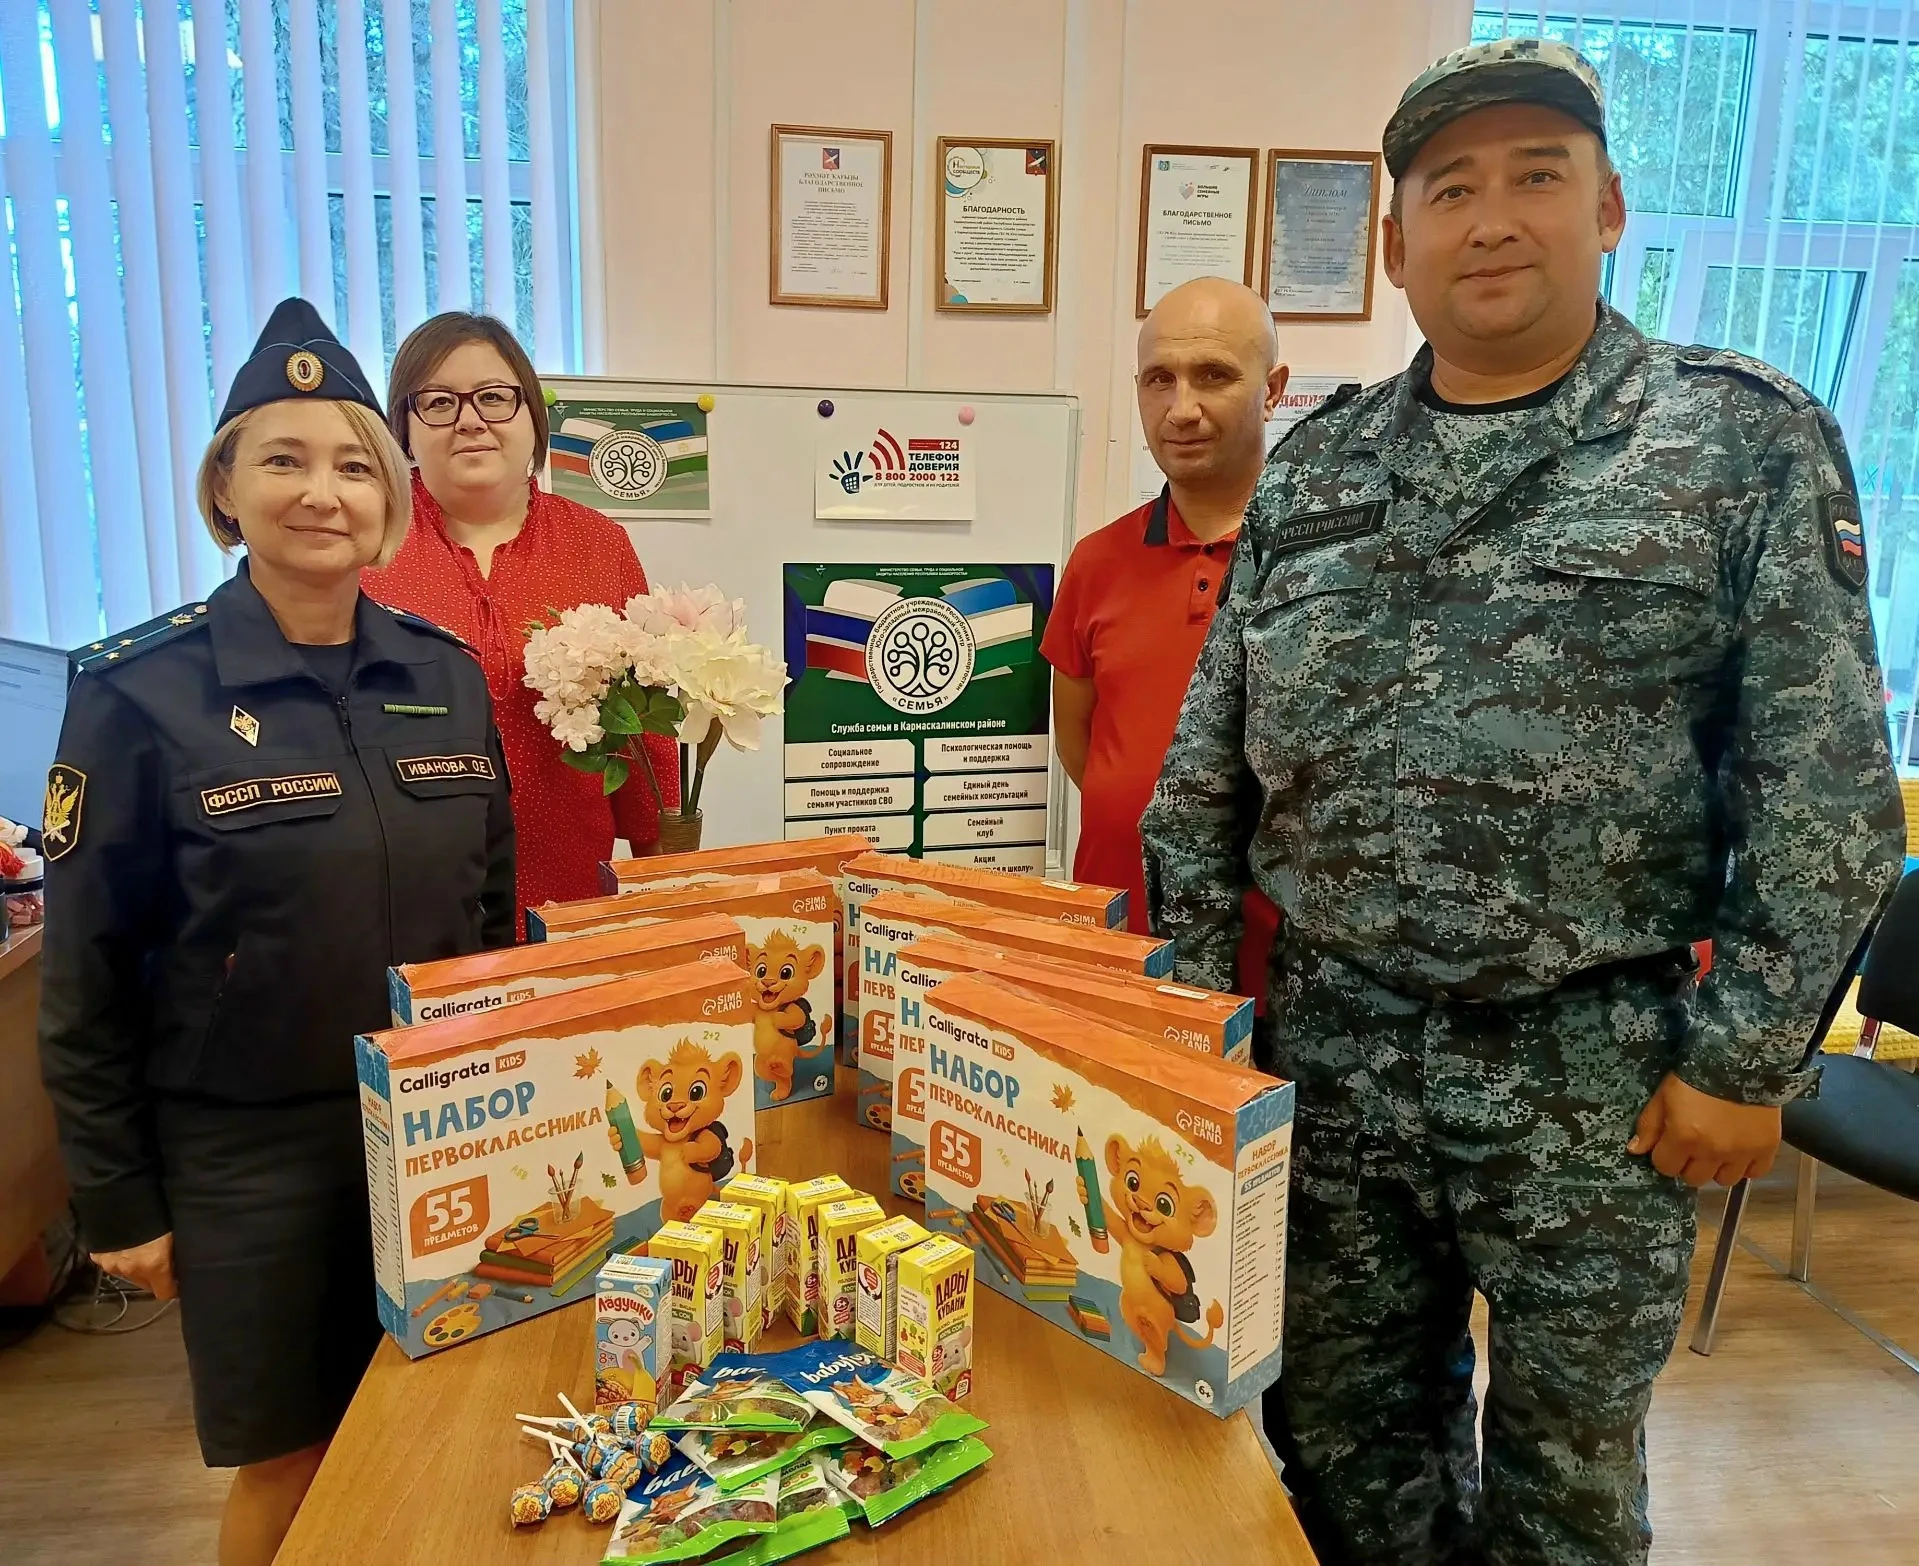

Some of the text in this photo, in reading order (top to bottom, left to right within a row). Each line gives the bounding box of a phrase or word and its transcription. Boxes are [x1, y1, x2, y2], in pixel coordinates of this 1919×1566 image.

[963, 205, 1026, 214] БЛАГОДАРНОСТЬ
[1163, 210, 1233, 219] БЛАГОДАРСТВЕННОЕ
[939, 441, 958, 450] 124
[908, 453, 959, 461] ТЕЛЕФОН
[908, 463, 959, 472] ДОВЕРИЯ
[875, 473, 959, 482] 8 800 2000 122
[892, 696, 949, 711] «СЕМЬЯ»
[831, 719, 1006, 735] Служба семьи в Кармаскалинском районе
[828, 748, 873, 758] Социальное
[941, 742, 1032, 753] Психологическая помощь
[821, 759, 880, 770] сопровождение
[969, 754, 1010, 764] поддержка
[407, 760, 468, 775] ИВАНОВА
[810, 788, 840, 797] Помощь
[847, 786, 890, 796] поддержка
[963, 780, 1009, 791] Единый день
[208, 777, 337, 808] ФССП РОССИИ
[943, 790, 1028, 802] семейных консультаций
[806, 796, 893, 809] семьям участников СВО
[967, 816, 1004, 827] Семейный
[824, 824, 876, 836] Пункт проката
[976, 829, 994, 838] клуб
[973, 855, 996, 864] Акция
[1007, 865, 1034, 874] школу»
[848, 881, 879, 898] Callig
[805, 896, 826, 905] SIMA
[805, 903, 827, 913] LAND
[1073, 914, 1096, 925] SIMA
[792, 924, 808, 934] 2+2
[864, 921, 914, 942] Calligrat
[714, 945, 737, 957] SIMA
[717, 991, 742, 1001] SIMA
[717, 1000, 743, 1013] LAND
[703, 1030, 720, 1041] 2+2
[928, 1014, 988, 1050] Calligrata
[1181, 1029, 1210, 1044] SIMA
[399, 1061, 491, 1094] Calligrata
[929, 1043, 1020, 1109] НАБОР
[816, 1078, 827, 1088] 6+
[402, 1080, 536, 1148] НАБОР
[929, 1083, 1072, 1164] ПЕРВОКЛАССНИКА
[1194, 1115, 1222, 1136] SIMA
[405, 1106, 602, 1178] ПЕРВОКЛАССНИКА
[1193, 1125, 1223, 1146] LAND
[940, 1126, 971, 1167] 55
[1252, 1140, 1277, 1161] НАБОР
[1175, 1144, 1195, 1166] 2+2
[937, 1158, 974, 1183] ПРЕДМЕТОВ
[425, 1186, 474, 1233] 55
[424, 1223, 479, 1248] ПРЕДМЕТОВ
[836, 1234, 856, 1262] ДА
[671, 1260, 698, 1287] РЫ
[936, 1268, 970, 1311] ДАРЫ
[598, 1297, 653, 1322] Ладушки
[937, 1295, 966, 1322] КУБАНИ
[599, 1352, 616, 1364] 8+
[1198, 1385, 1212, 1399] 6+
